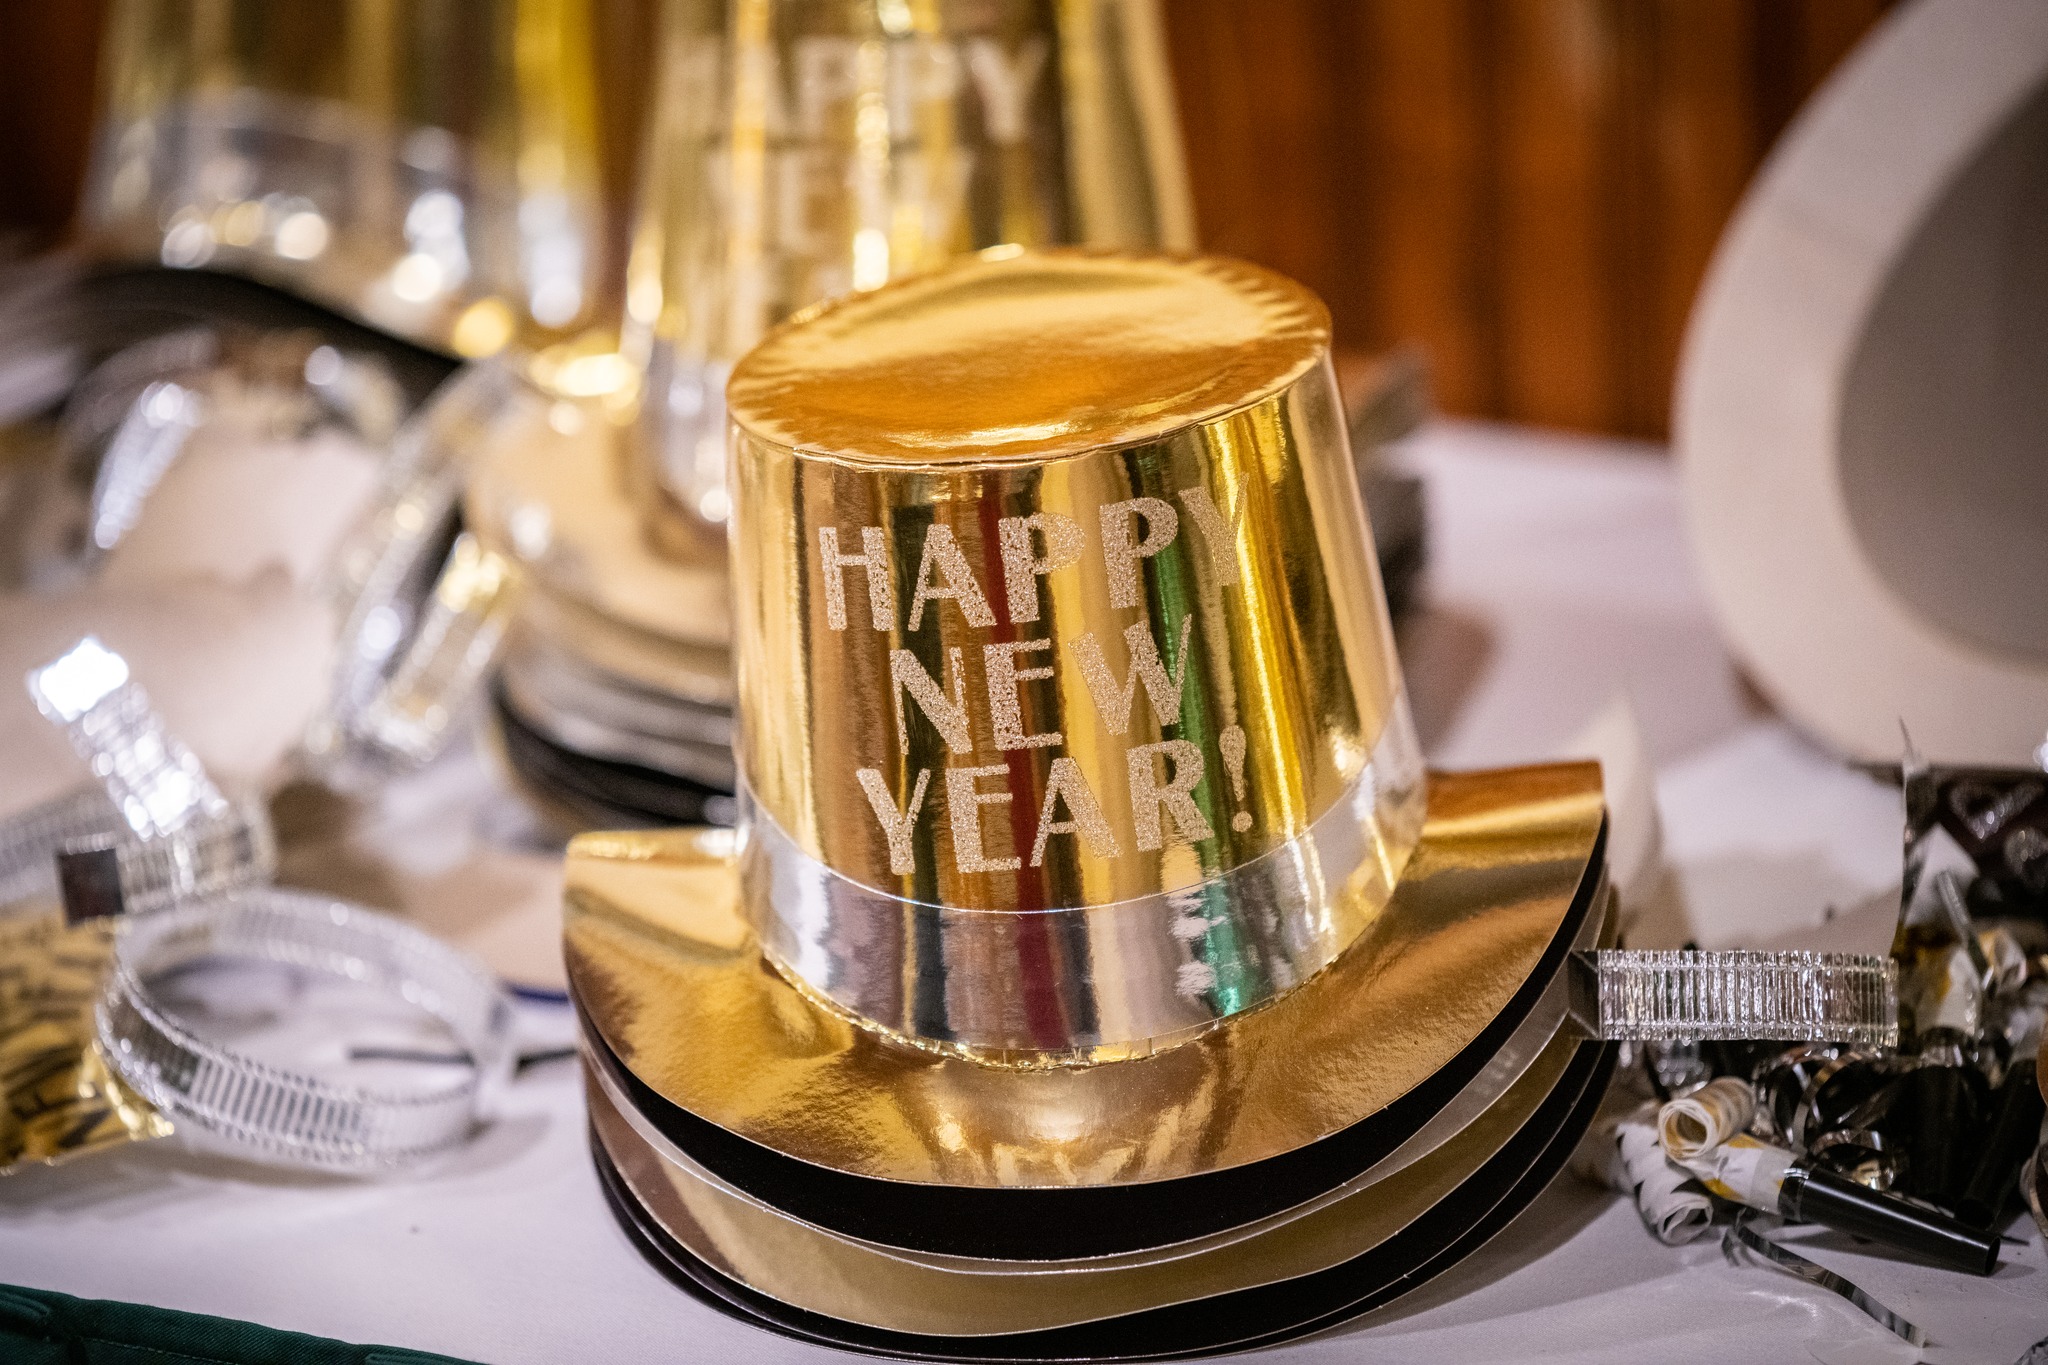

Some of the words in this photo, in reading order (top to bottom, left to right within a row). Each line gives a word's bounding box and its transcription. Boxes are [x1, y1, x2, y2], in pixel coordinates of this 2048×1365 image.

[818, 471, 1250, 632] HAPPY
[889, 613, 1193, 755] NEW
[856, 724, 1253, 876] YEAR!
